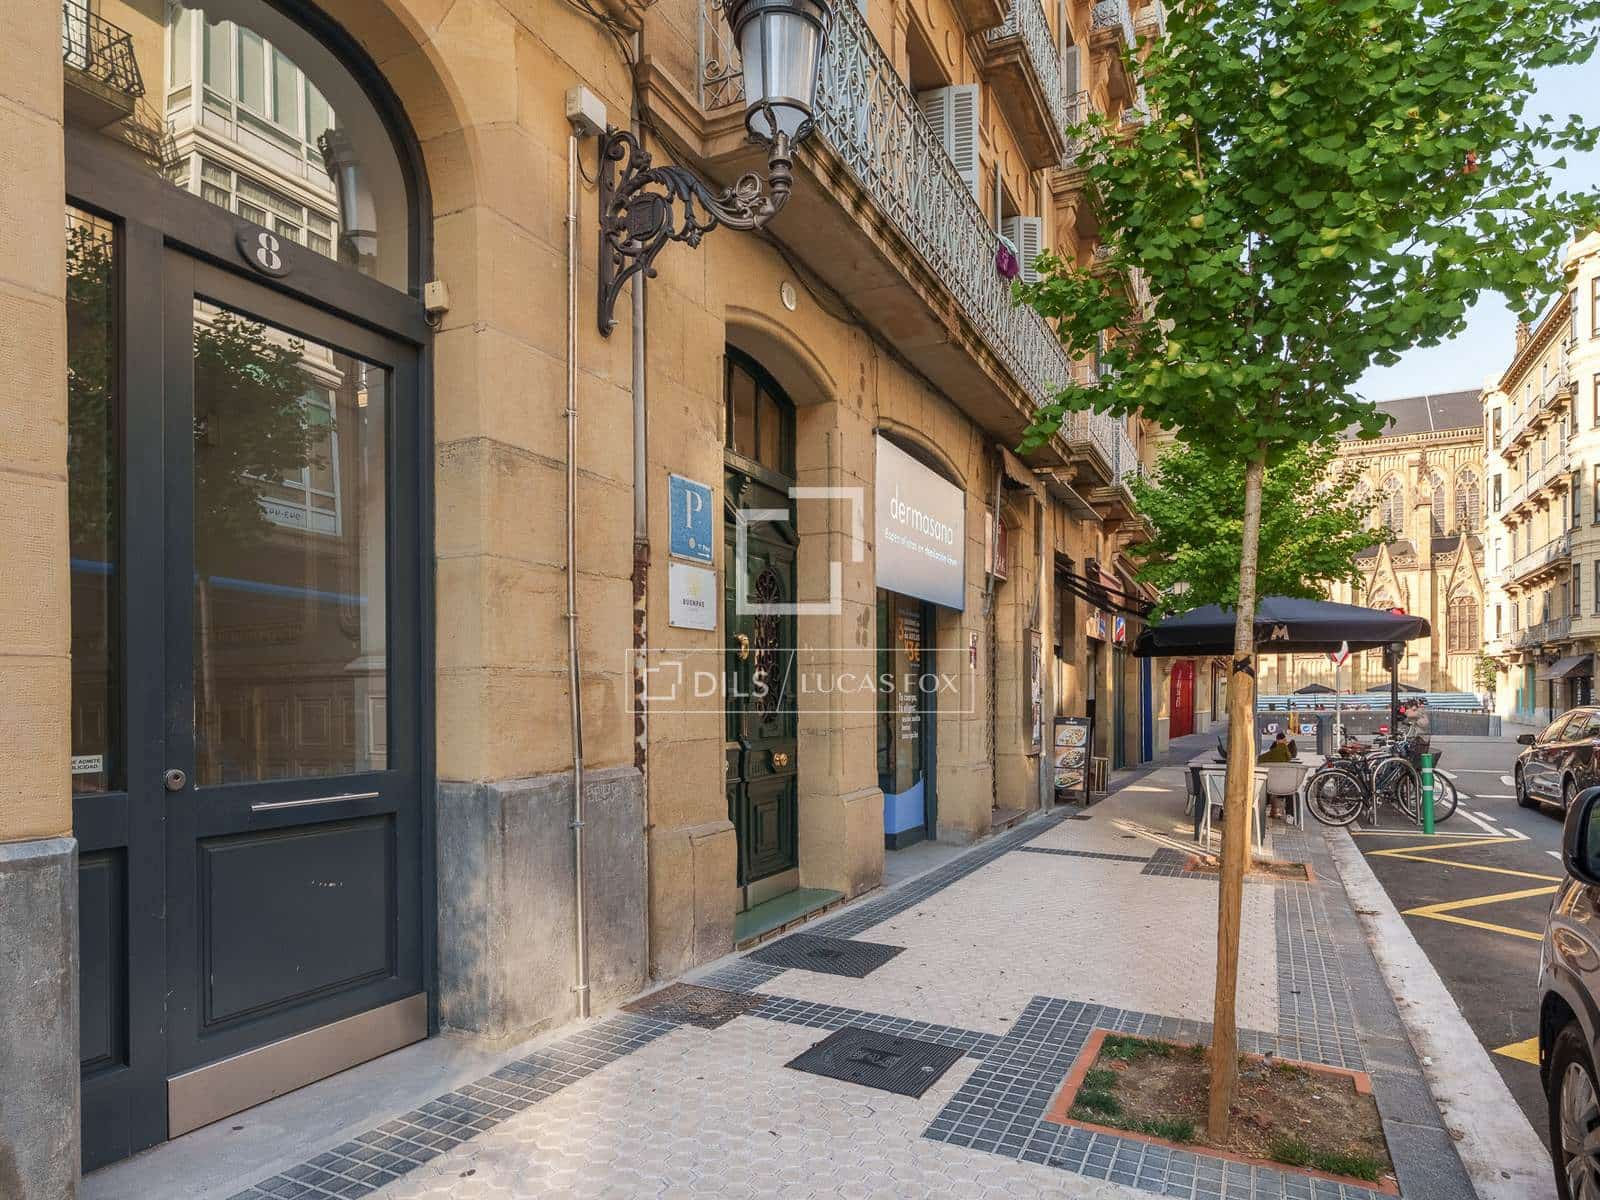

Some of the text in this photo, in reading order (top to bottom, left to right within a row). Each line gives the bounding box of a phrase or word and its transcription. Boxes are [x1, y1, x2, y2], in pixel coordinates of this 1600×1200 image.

[257, 233, 281, 269] 8
[685, 489, 703, 528] P
[1271, 624, 1290, 640] M
